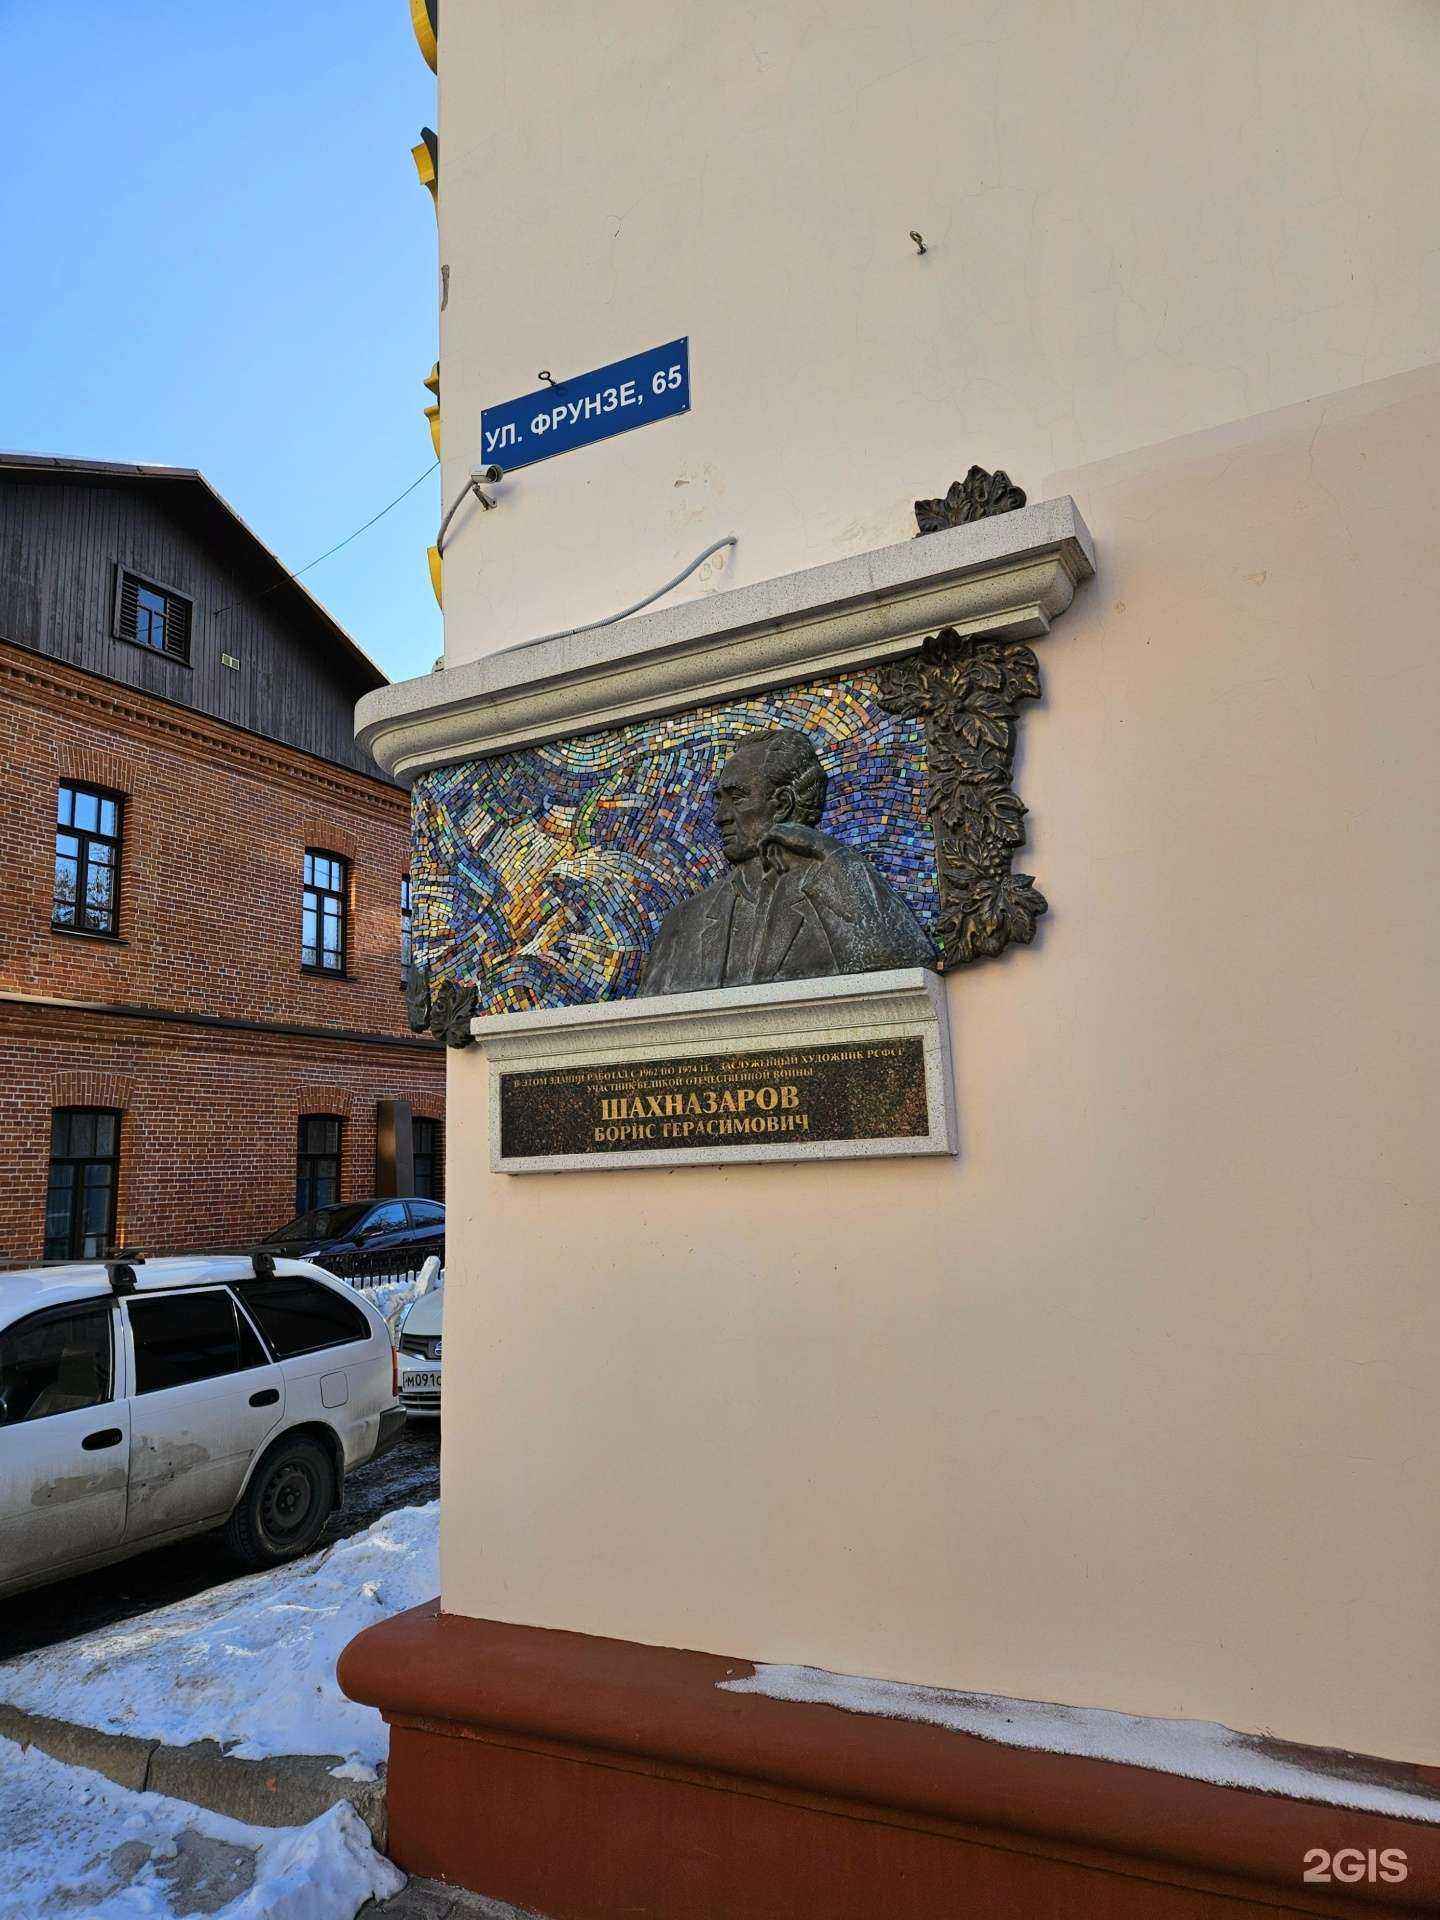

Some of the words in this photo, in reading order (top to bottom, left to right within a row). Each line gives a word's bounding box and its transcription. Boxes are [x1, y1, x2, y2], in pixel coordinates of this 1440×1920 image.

[485, 423, 522, 452] УЛ.
[530, 381, 643, 436] ФРУНЗЕ,
[652, 364, 682, 395] 65
[801, 1049, 864, 1063] ХУДОЖНИК
[601, 1085, 801, 1120] ШАХНАЗАРОВ
[594, 1124, 657, 1142] БОРИС
[663, 1114, 809, 1138] ГЕРАСИМОВИЧ
